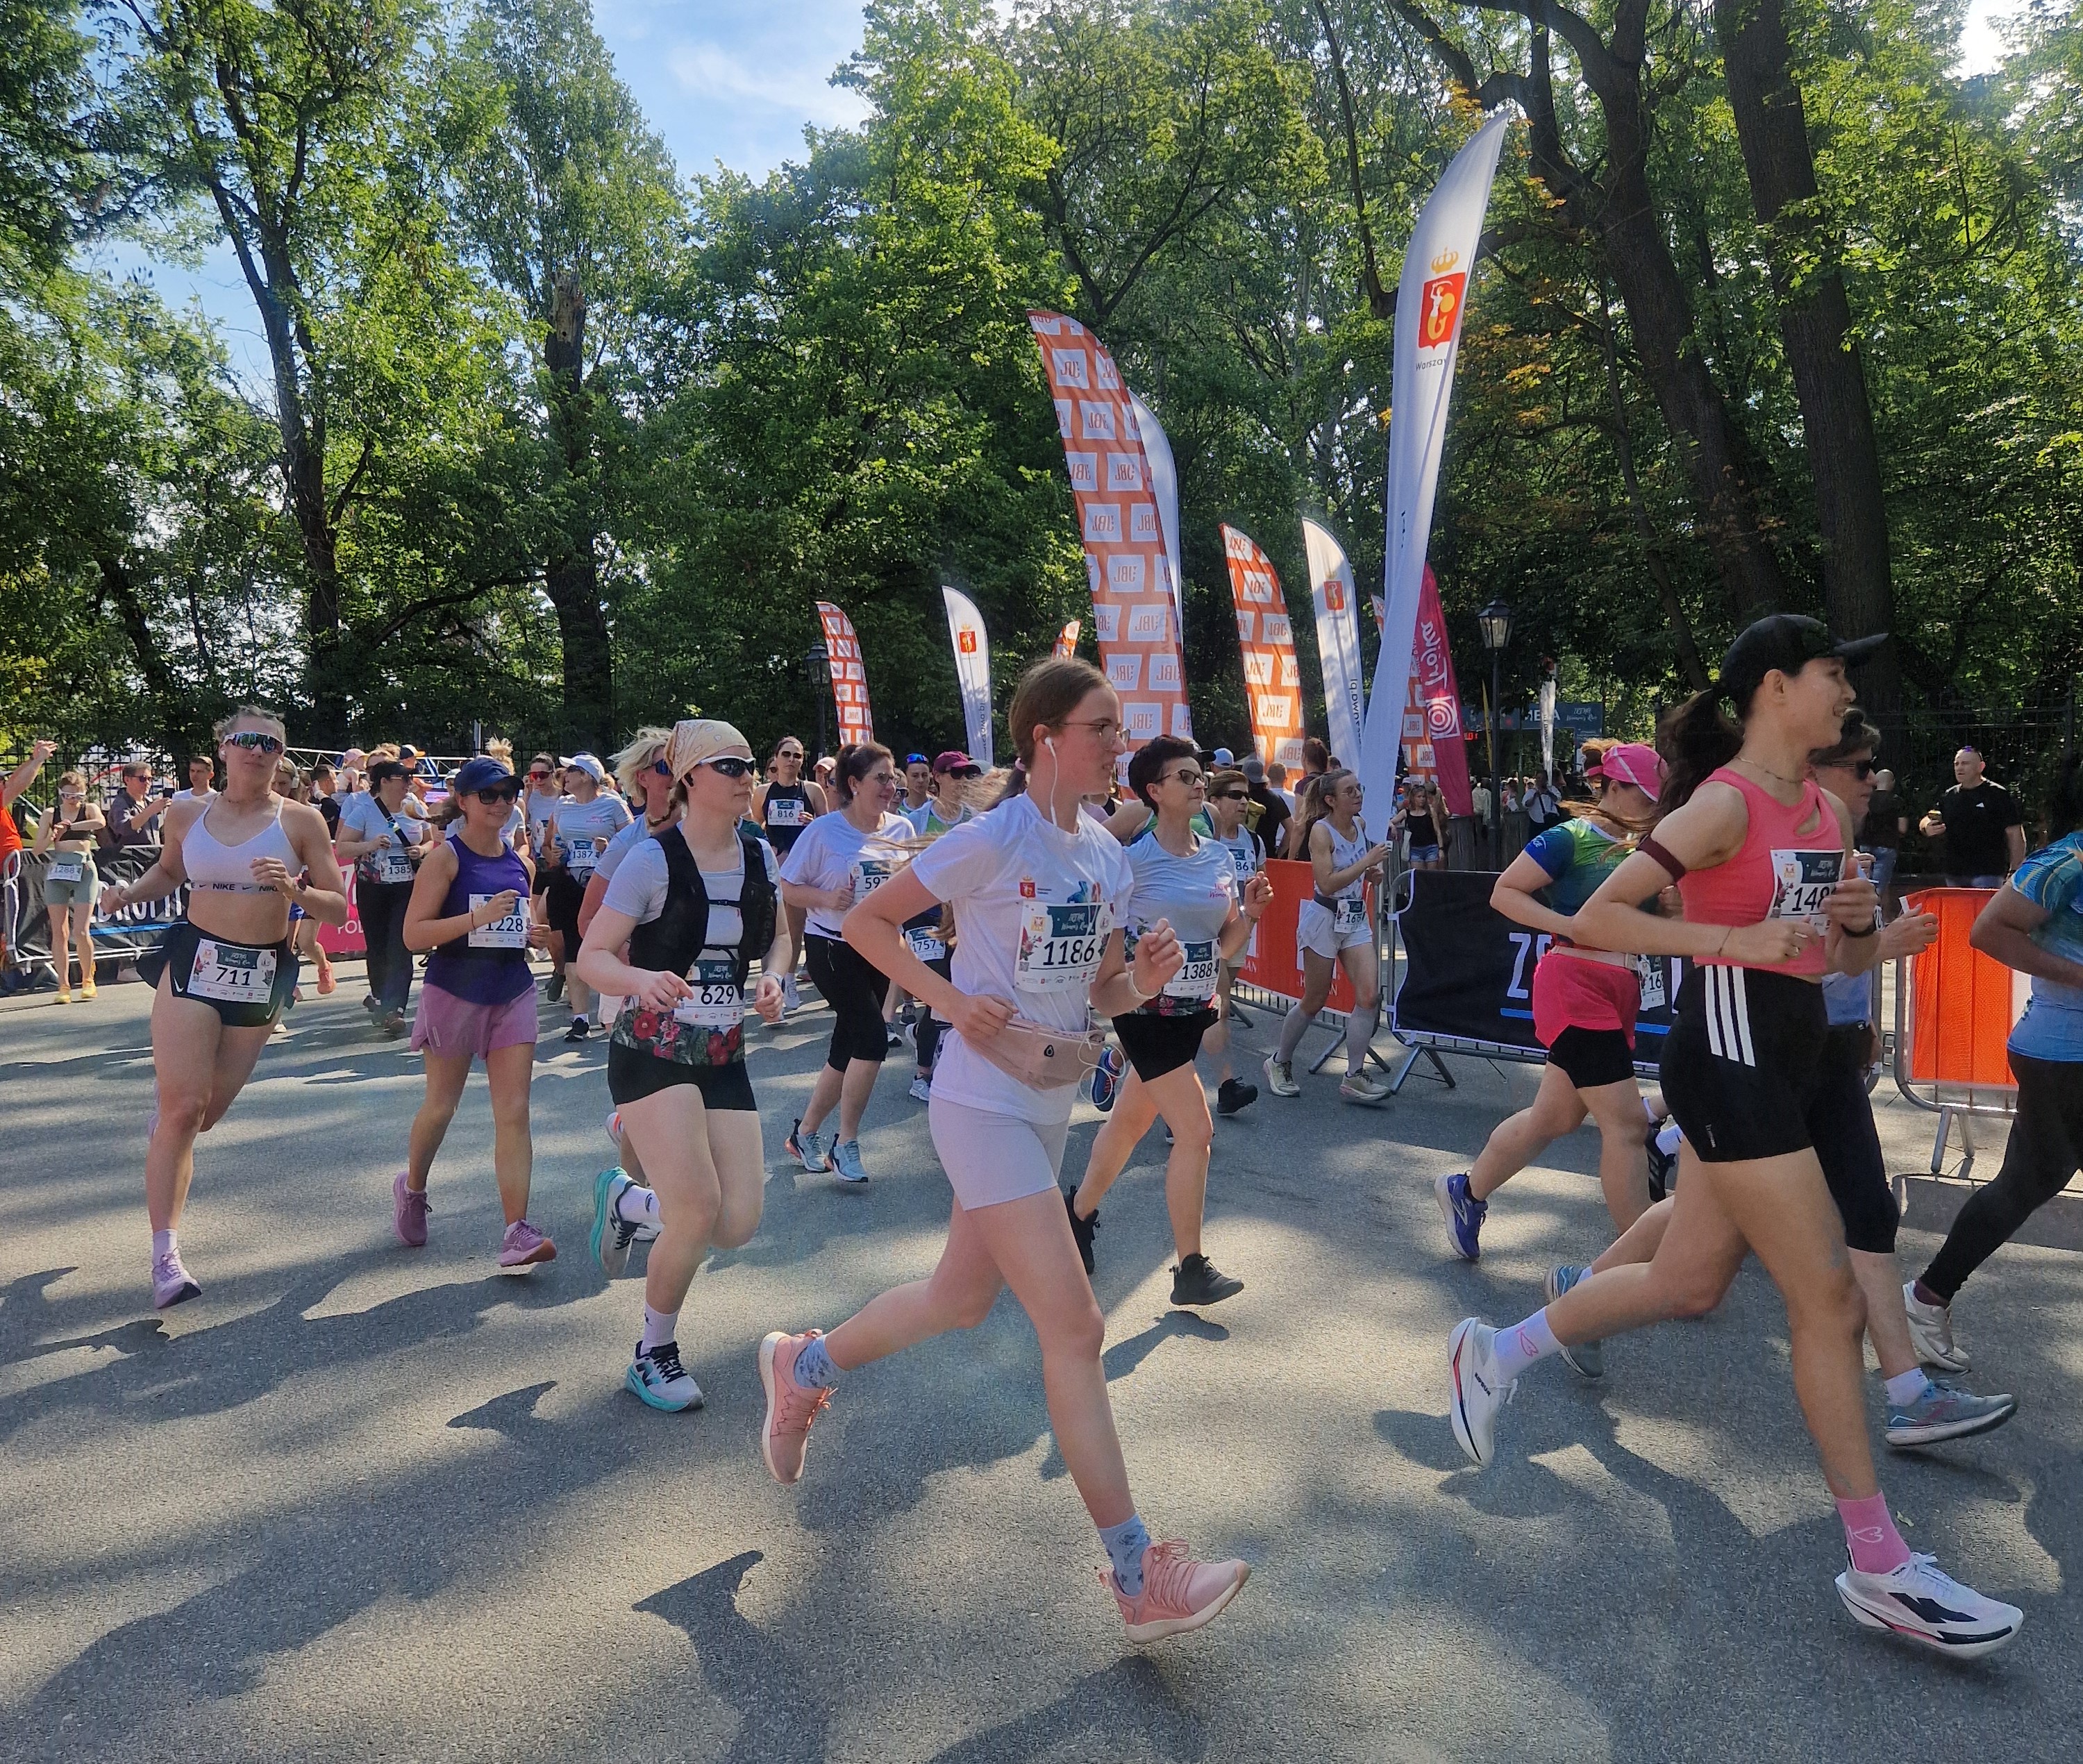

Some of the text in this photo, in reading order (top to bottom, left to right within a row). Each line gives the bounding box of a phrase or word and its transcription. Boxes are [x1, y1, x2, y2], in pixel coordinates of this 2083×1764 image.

[1416, 358, 1446, 371] Warsza
[573, 850, 593, 859] 1387
[55, 865, 74, 874] 1288
[389, 865, 411, 875] 1385
[1236, 862, 1248, 871] 86
[1792, 887, 1836, 912] 148
[485, 917, 524, 932] 1228
[912, 940, 936, 952] 1757
[1043, 939, 1096, 965] 1186
[216, 966, 250, 986] 711
[1182, 962, 1212, 980] 1388
[701, 986, 734, 1005] 629
